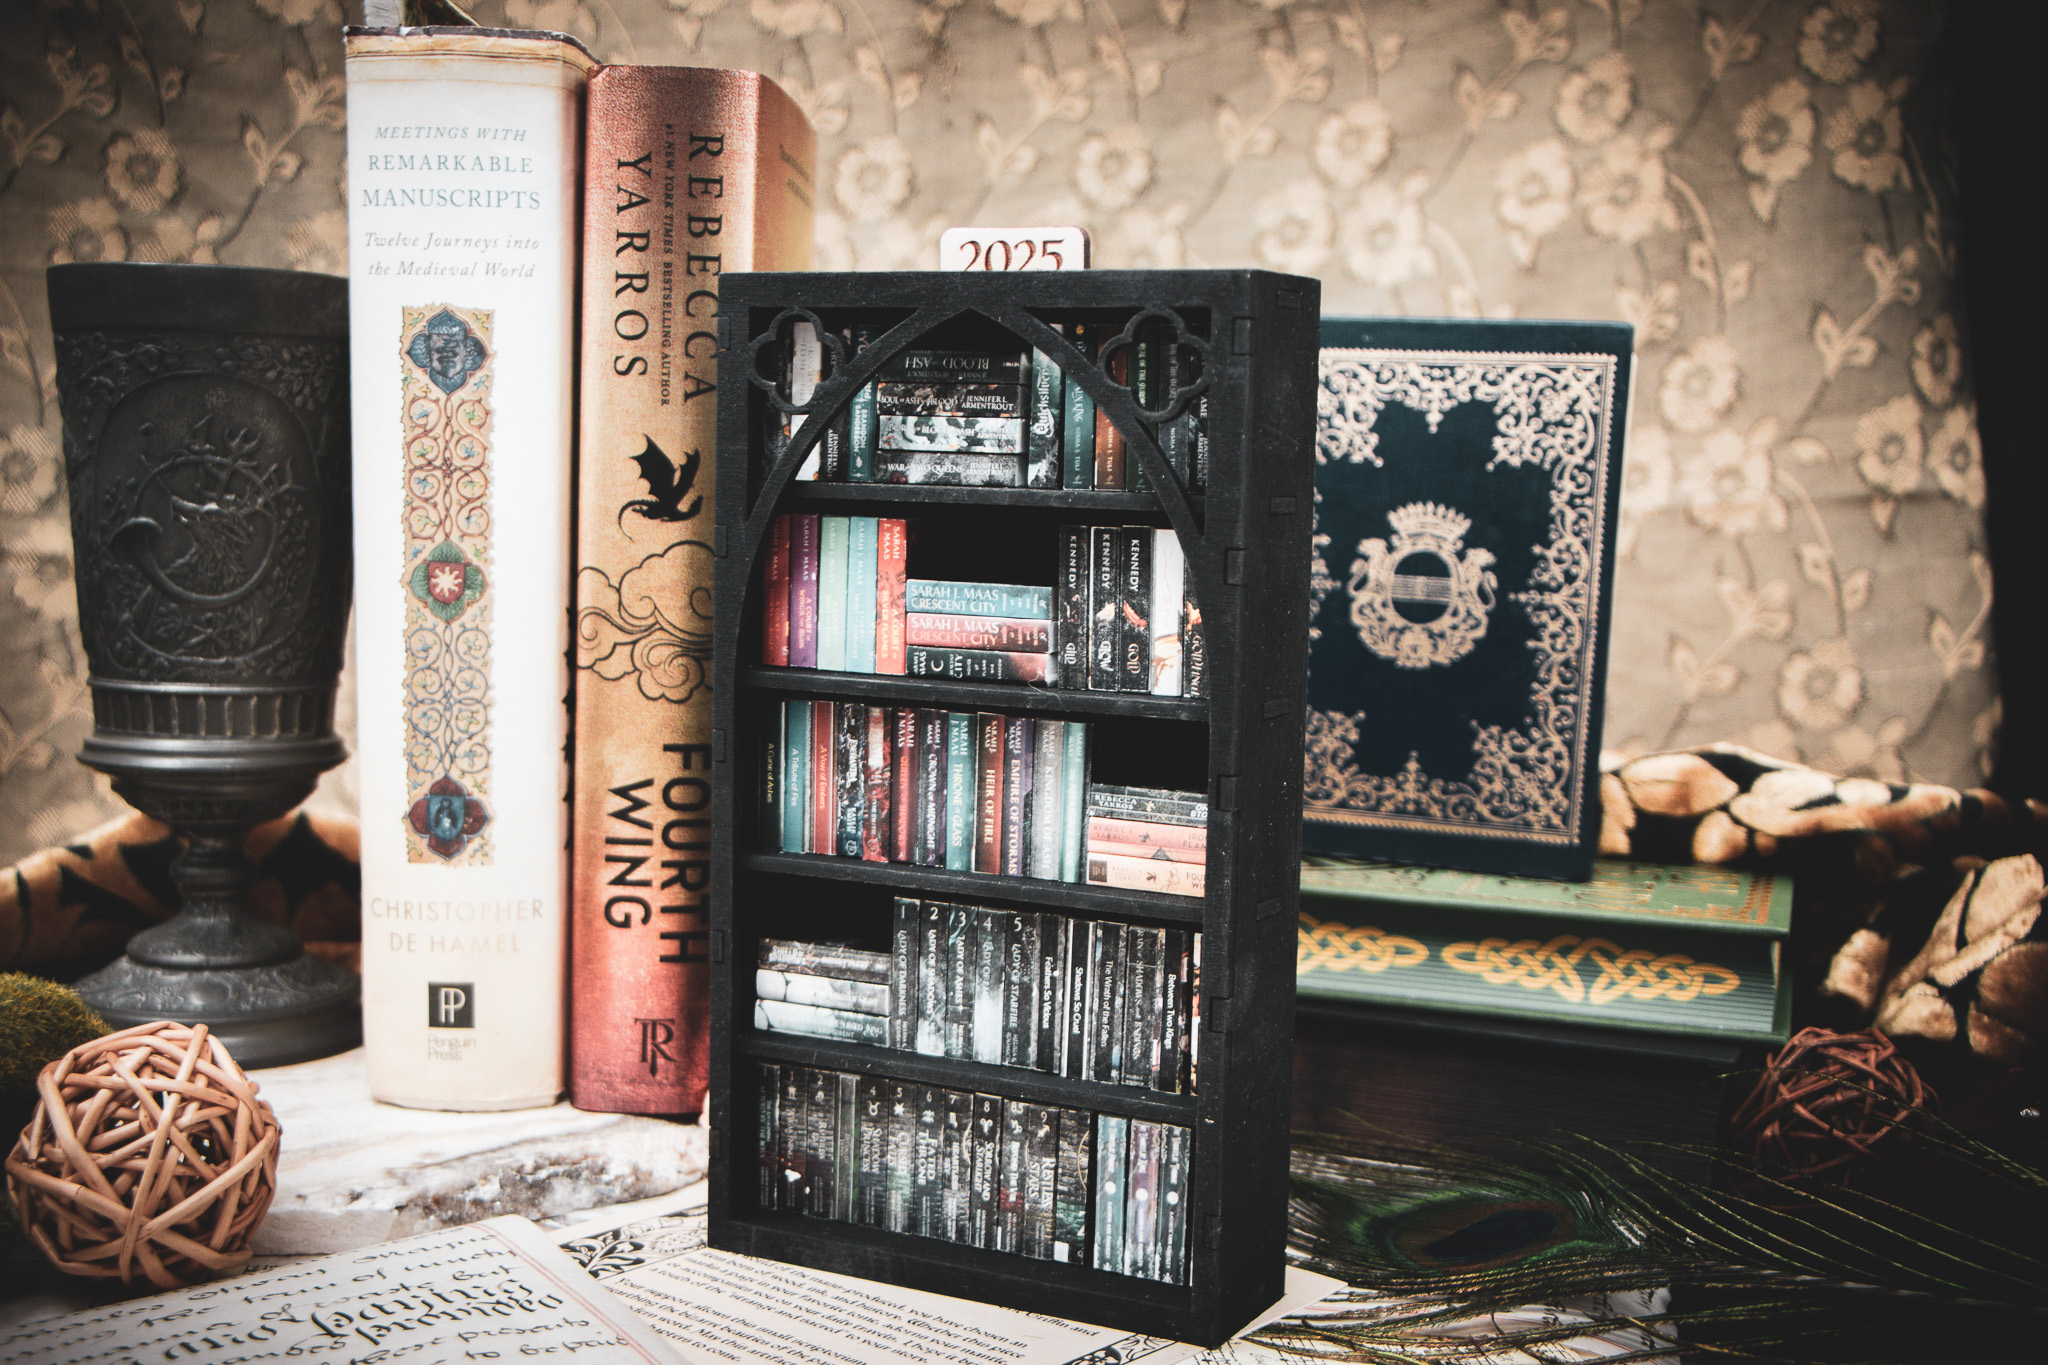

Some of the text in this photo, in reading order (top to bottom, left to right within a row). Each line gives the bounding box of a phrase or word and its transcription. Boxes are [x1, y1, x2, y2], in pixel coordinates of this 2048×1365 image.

[375, 126, 528, 142] MEETINGS WITH
[368, 155, 535, 173] REMARKABLE
[362, 188, 541, 210] MANUSCRIPTS
[364, 231, 541, 253] Twelve Journeys into
[958, 239, 1066, 271] 2025
[368, 261, 537, 279] the Medieval World
[613, 151, 653, 377] YARROS
[661, 140, 675, 407] NEW YORK TIMES BESTSELLING AUTHOR
[683, 130, 725, 404] REBECCA
[905, 356, 990, 370] BLOOD ASH
[961, 402, 1014, 411] ARMENTROUT
[853, 404, 862, 453] SANDERSON
[860, 409, 869, 449] BRANDON
[857, 521, 865, 551] SARAH
[883, 531, 891, 560] MAAS
[893, 525, 901, 559] SARAH
[802, 556, 810, 581] MAAS
[1069, 535, 1078, 589] KENNEDY
[1101, 533, 1111, 590] KENNEDY
[1129, 539, 1141, 593] KENNEDY
[910, 585, 1000, 601] SARAH MAAS
[910, 597, 998, 613] CRESCENT CITY
[891, 620, 900, 650] COURT
[911, 616, 1000, 634] SARAH MAAS
[911, 629, 999, 646] CRESCENT CITY
[881, 623, 889, 658] FLAMES
[897, 719, 907, 748] MAAS
[906, 712, 915, 748] SARAH
[950, 727, 960, 756] MAAS
[960, 720, 969, 755] SARAH
[984, 724, 992, 748] MAAS
[990, 720, 998, 748] SARAH
[1008, 725, 1017, 750] MAAS
[1014, 720, 1022, 750] SARAH
[766, 750, 774, 803] Curse Ashes
[791, 756, 800, 806] Tribute Fire
[818, 753, 828, 808] Vow Embers
[926, 752, 938, 850] CROWN MIDNIGHT
[951, 763, 963, 847] THRONE GLASS
[983, 769, 997, 844] HEIR OF FIRE
[1007, 759, 1021, 875] EMPIRE OF STORMS
[1041, 765, 1055, 869] KINGDOM OF ASH
[605, 778, 655, 929] WING
[660, 743, 712, 963] FOURTH
[371, 897, 543, 922] CHRISTOPHER
[929, 906, 939, 920] 2
[957, 911, 967, 927] 3
[983, 916, 993, 932] 4
[1013, 916, 1023, 932] 5
[389, 931, 520, 954] DE HAMEL
[956, 934, 967, 959] LADY
[981, 940, 993, 965] LADY
[897, 929, 907, 1016] LADY OF DARKNESS
[925, 929, 937, 1015] LADY OF SHADOWS
[955, 960, 966, 975] OF
[1009, 943, 1021, 1029] LADY STARFIRE
[1042, 956, 1054, 1030] Feathers Vicious
[1072, 966, 1084, 1035] Shadows So Cruel
[1100, 960, 1114, 1048] The Wrath Fallen
[1163, 973, 1177, 1050] Between Two Kings
[428, 1034, 477, 1050] Penguin
[428, 1047, 463, 1060] Press
[983, 1100, 991, 1113] 8
[916, 1128, 929, 1186] THRONE
[926, 1138, 938, 1181] FATED
[983, 1141, 995, 1180] SORROW
[981, 1180, 992, 1202] AND
[1027, 1161, 1040, 1199] STARS
[1040, 1156, 1056, 1210] RESTLESS
[352, 1266, 388, 1282] of
[808, 1276, 1010, 1344] mass-produced, have chosen
[458, 1316, 591, 1345] presents
[678, 1311, 771, 1346] bizarre beauties
[692, 1303, 868, 1365] allows small scriptorium
[800, 1294, 1008, 1365] favorite adorns your mantle,
[820, 1313, 899, 1343] daily travels.
[830, 1294, 1027, 1360] and history. Whether this piece
[1070, 1325, 1100, 1337] and
[465, 1345, 502, 1361] to
[707, 1347, 742, 1362] come.
[891, 1348, 929, 1364] story.
